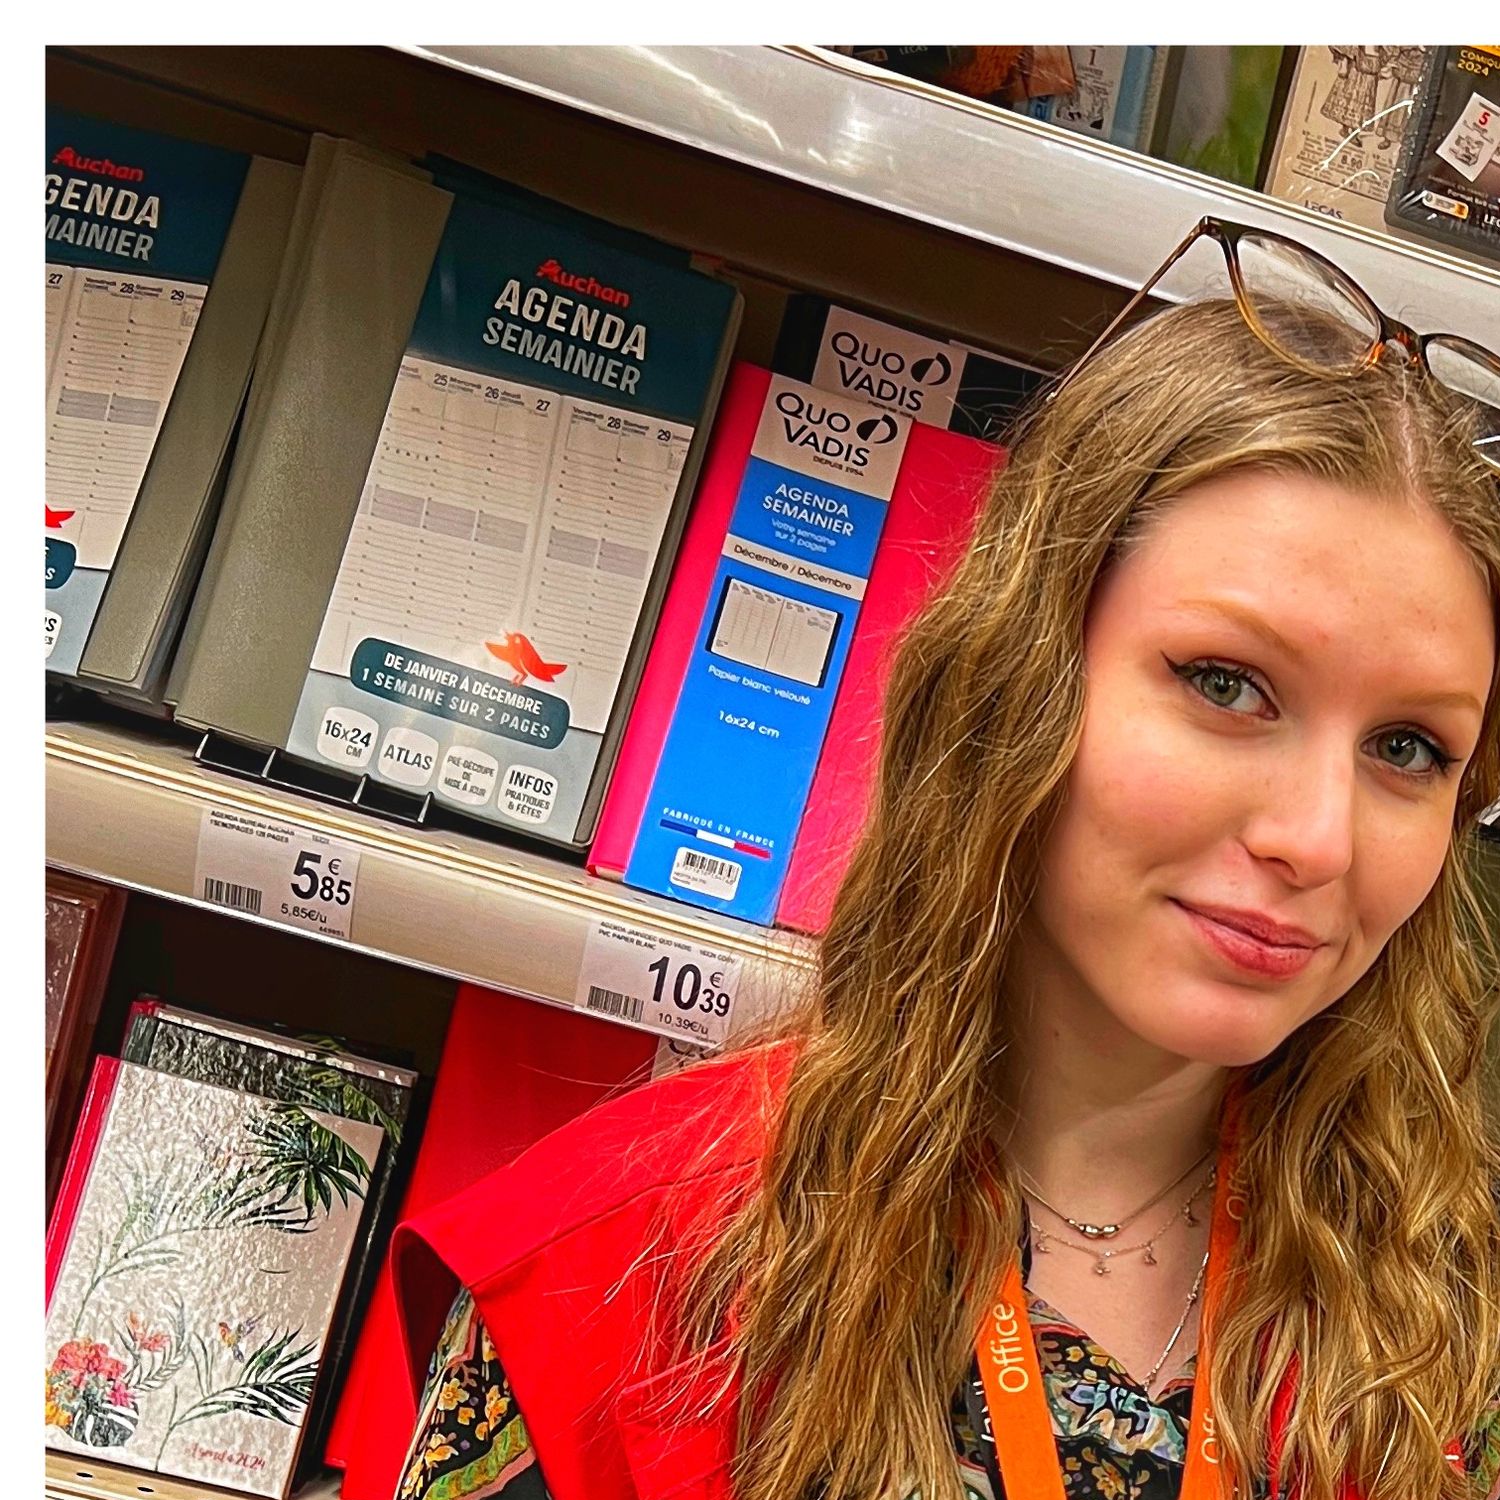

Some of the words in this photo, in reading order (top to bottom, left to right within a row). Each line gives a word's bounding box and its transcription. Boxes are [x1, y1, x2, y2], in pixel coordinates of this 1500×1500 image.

[1479, 112, 1491, 126] 5
[53, 146, 144, 182] Auchan
[537, 258, 630, 307] Auchan
[493, 278, 648, 362] AGENDA
[482, 316, 642, 395] SEMAINIER
[831, 331, 905, 374] QUO
[839, 360, 924, 411] VADIS
[776, 392, 850, 432] QUO
[784, 418, 870, 466] VADIS
[762, 496, 854, 536] SEMAINIER
[775, 483, 849, 517] AGENDA
[384, 652, 402, 669] DE
[403, 656, 458, 686] JANVIER
[472, 681, 543, 716] DÉCEMBRE
[708, 664, 741, 684] Papier
[743, 673, 771, 693] blanc
[362, 668, 369, 681] 1
[373, 673, 444, 706] SEMAINE
[449, 697, 478, 717] SUR
[484, 708, 494, 721] 2
[501, 712, 550, 739] PAGES
[324, 719, 372, 747] 16x24
[718, 709, 756, 733] 16x24
[759, 726, 780, 739] cm
[346, 744, 362, 758] CM
[384, 744, 432, 770] ATLAS
[505, 789, 550, 810] PRATIQUES
[508, 769, 554, 796] INFOS
[663, 808, 712, 828] FABRIQUÉ
[718, 824, 731, 833] EN
[736, 829, 775, 847] FRANCE
[998, 1301, 1030, 1393] Office
